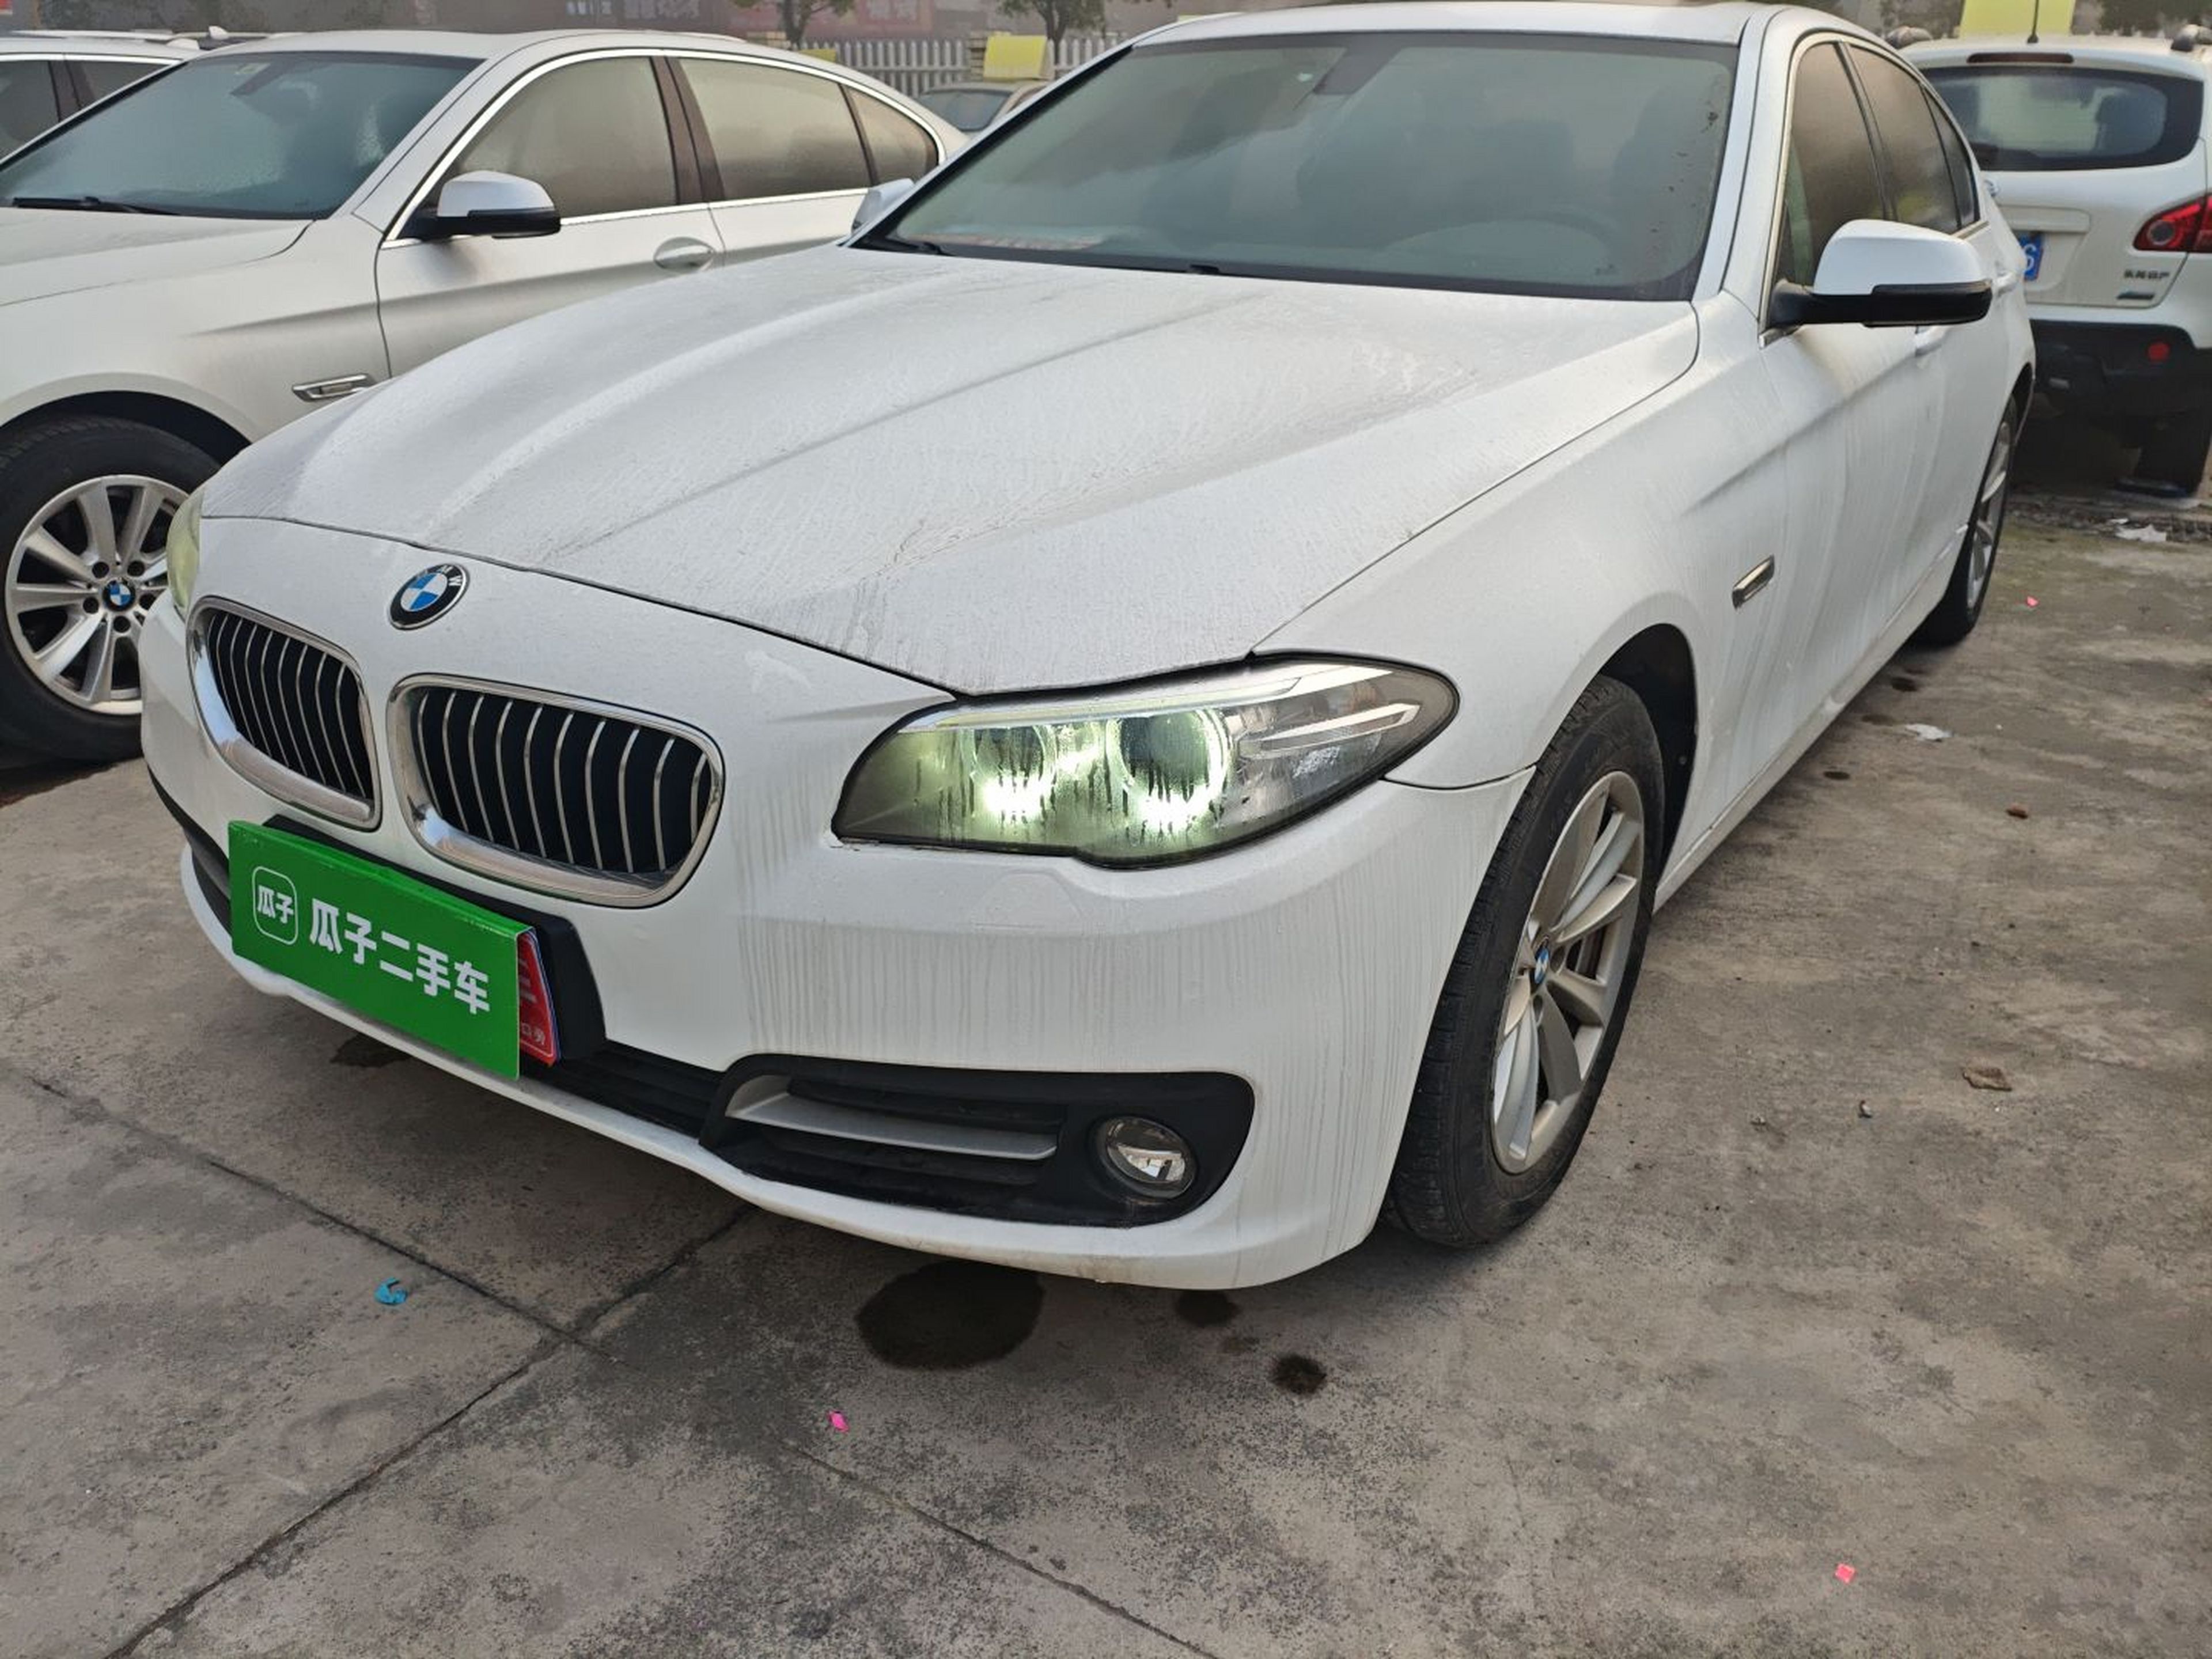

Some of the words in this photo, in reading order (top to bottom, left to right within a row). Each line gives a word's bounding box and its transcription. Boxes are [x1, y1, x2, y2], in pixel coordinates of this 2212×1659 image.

[257, 885, 294, 923] 瓜子
[309, 897, 490, 1014] 瓜子二手车
